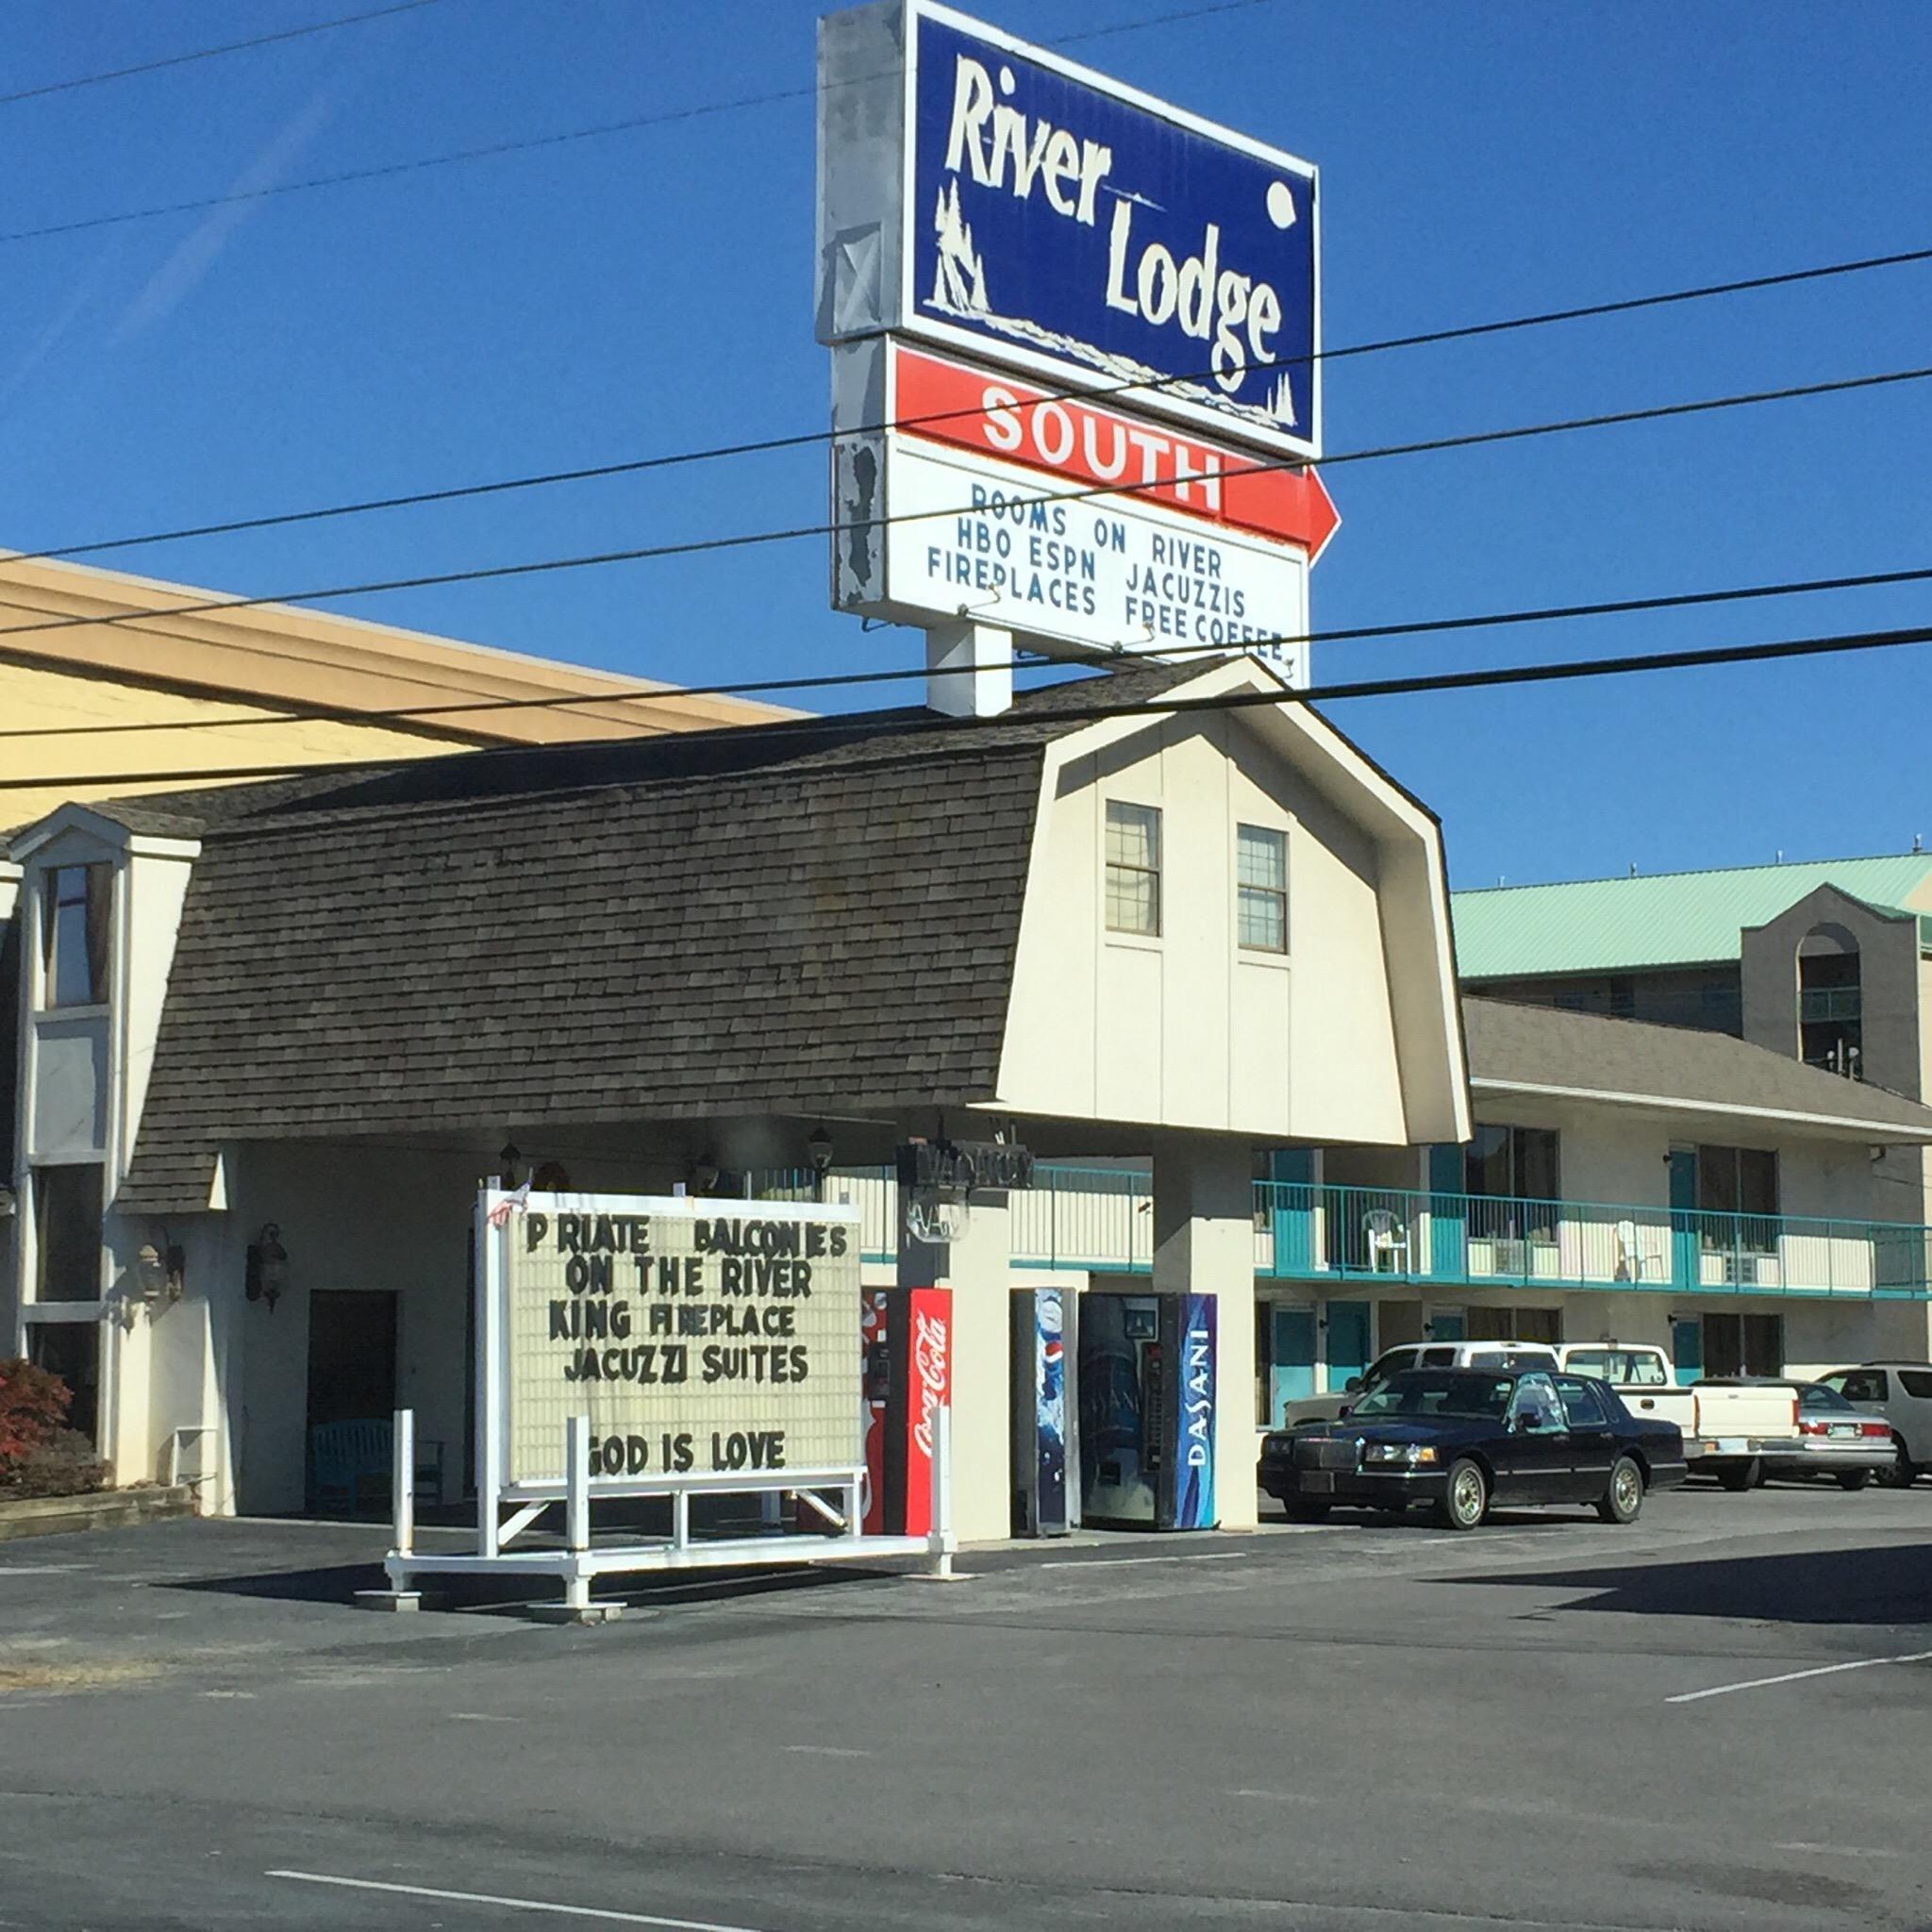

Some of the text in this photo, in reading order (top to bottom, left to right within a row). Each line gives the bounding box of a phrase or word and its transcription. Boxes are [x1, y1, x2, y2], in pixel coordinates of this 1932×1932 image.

[945, 53, 1111, 226] River
[1106, 200, 1281, 392] Lodge
[982, 386, 1221, 510] SOUTH
[958, 517, 1244, 618] HBO ESPN JACUZZIS
[972, 483, 1221, 578] ROOMS ON RIVER
[927, 546, 1282, 660] FIREPLACES FREE COFFEE
[549, 1300, 795, 1341] KING FIREPLACE
[566, 1255, 811, 1298] ON THE RIVER
[564, 1344, 808, 1384] JACUZZI SUITES
[1185, 1330, 1212, 1467] DASANI
[589, 1431, 786, 1477] GOD IS LOVE
